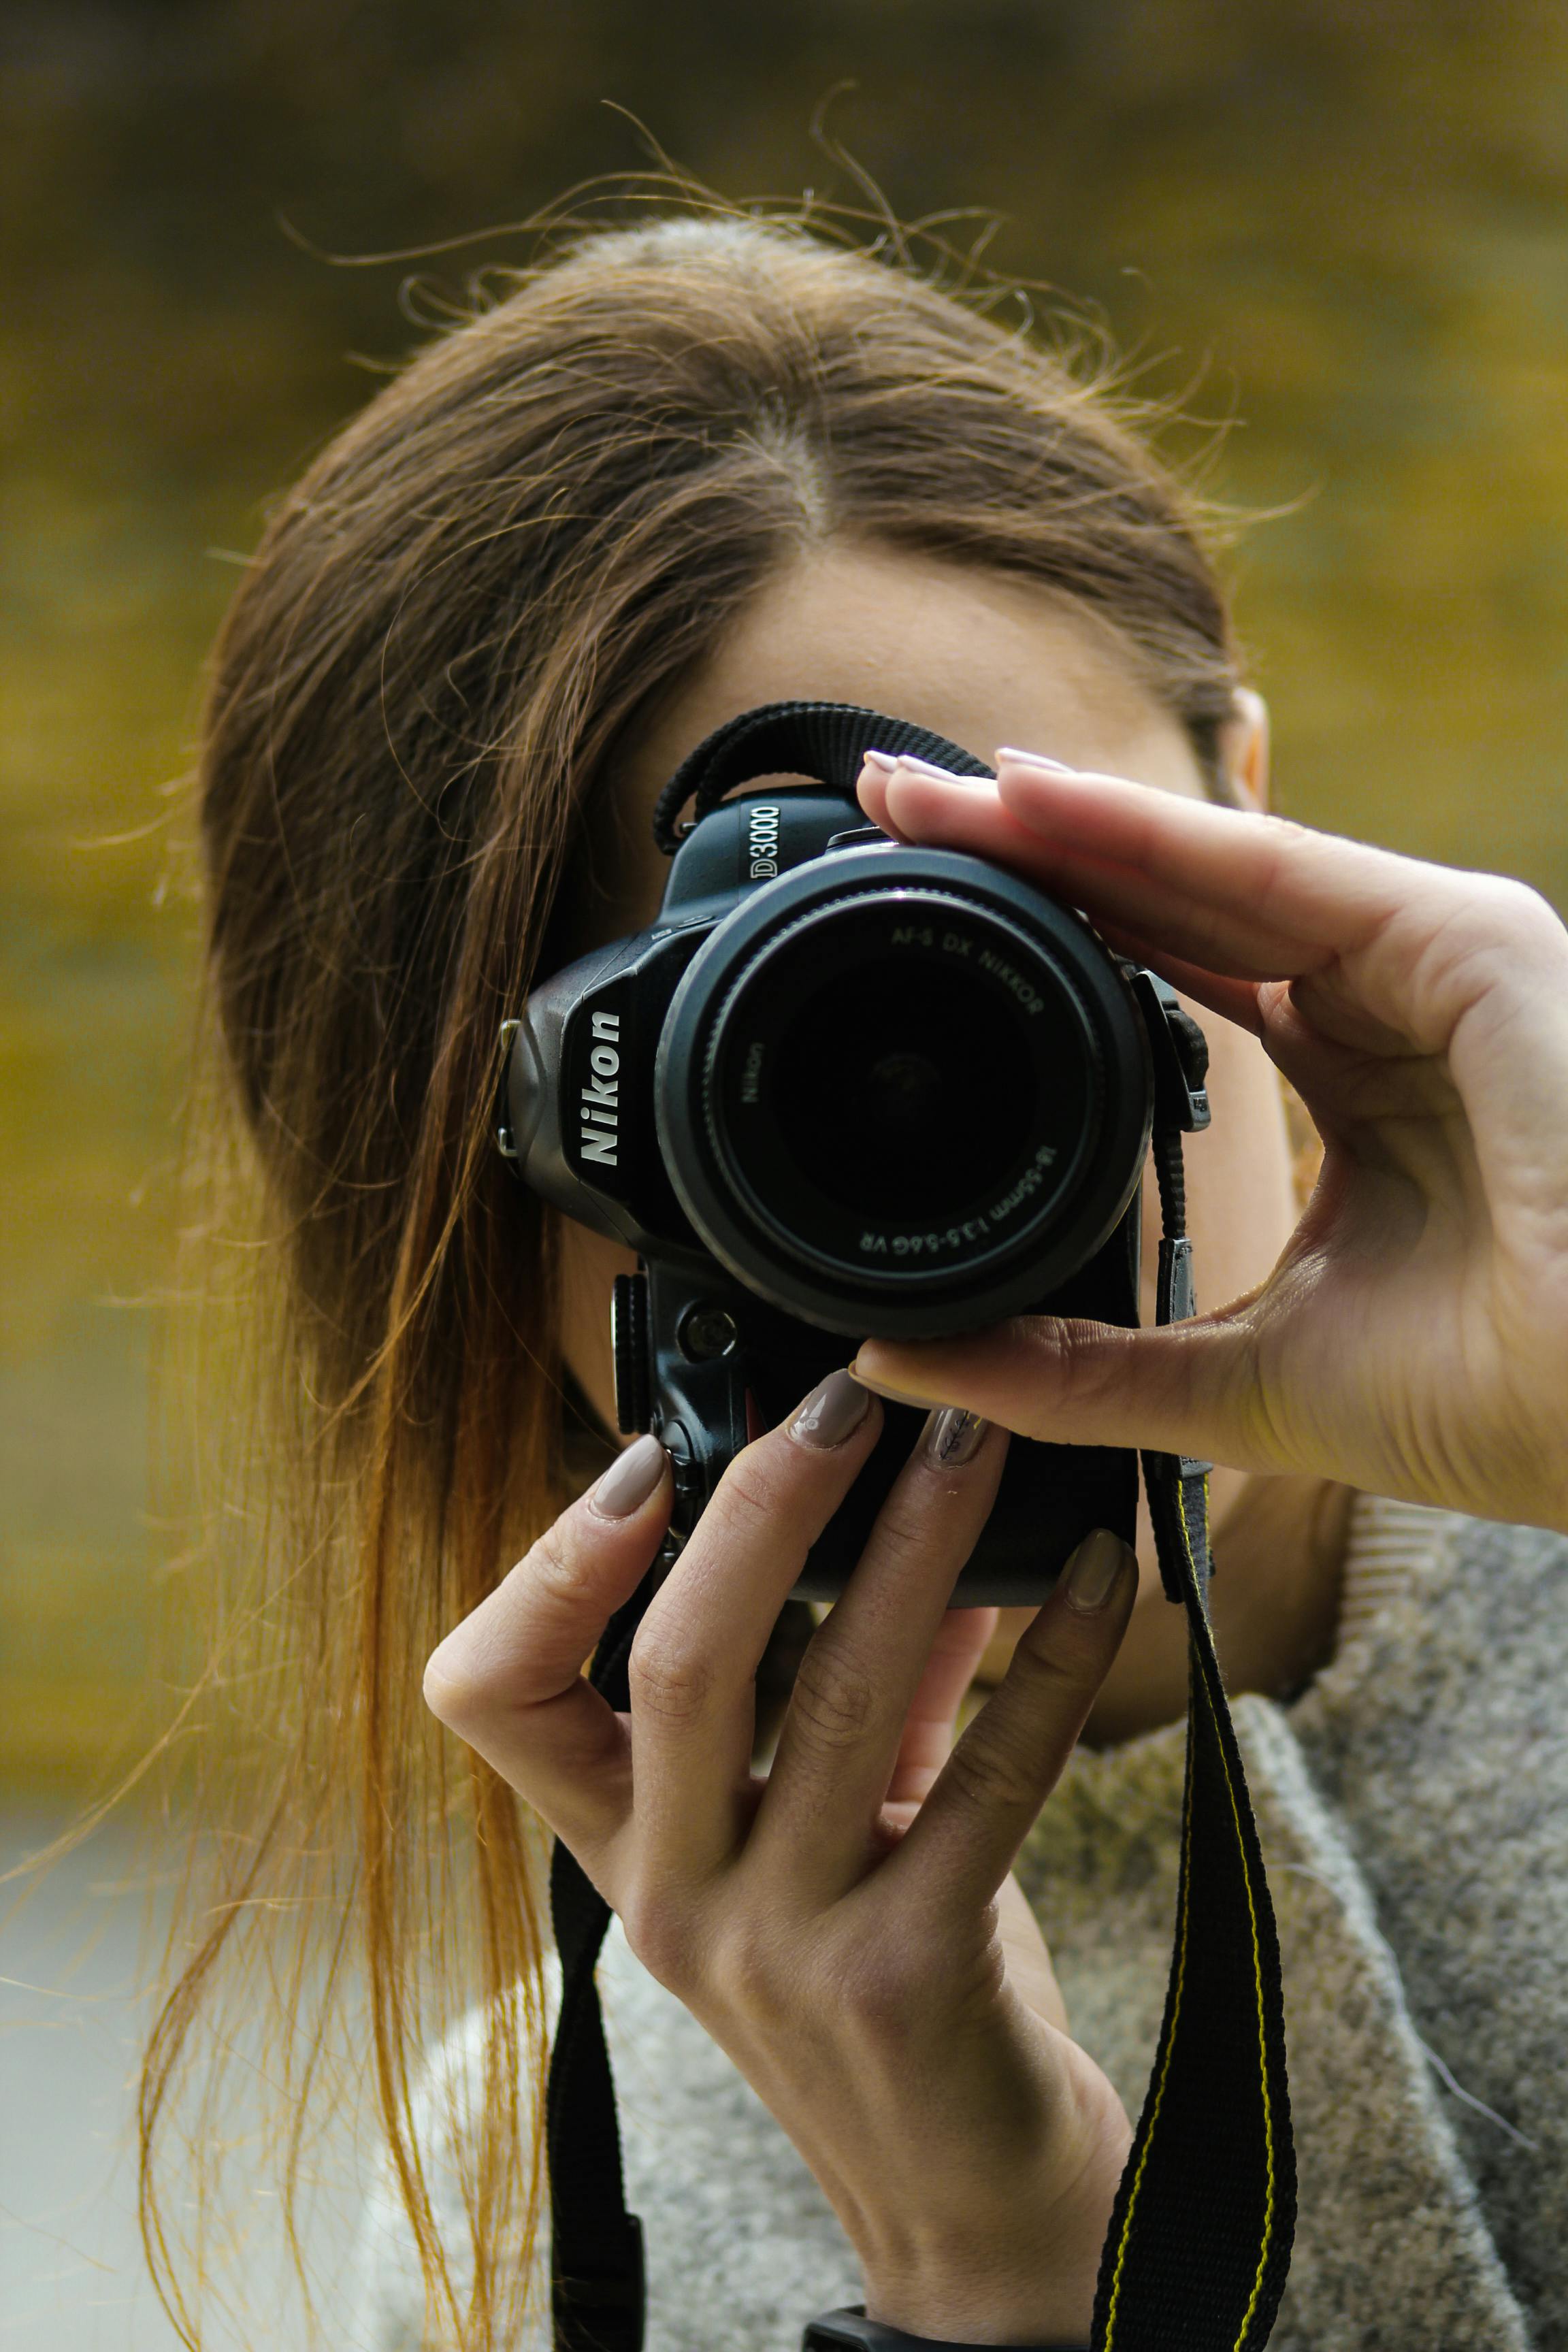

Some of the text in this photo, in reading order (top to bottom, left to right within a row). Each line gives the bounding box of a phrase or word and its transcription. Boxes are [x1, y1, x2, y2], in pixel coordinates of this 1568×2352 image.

[749, 806, 779, 879] D3000
[942, 931, 974, 958] DX
[978, 947, 1045, 1015] NIKKOR
[581, 1011, 620, 1166] Nikon
[740, 1042, 766, 1104] Nikon
[990, 1145, 1058, 1221] 18-55mm
[860, 1230, 888, 1254] VR
